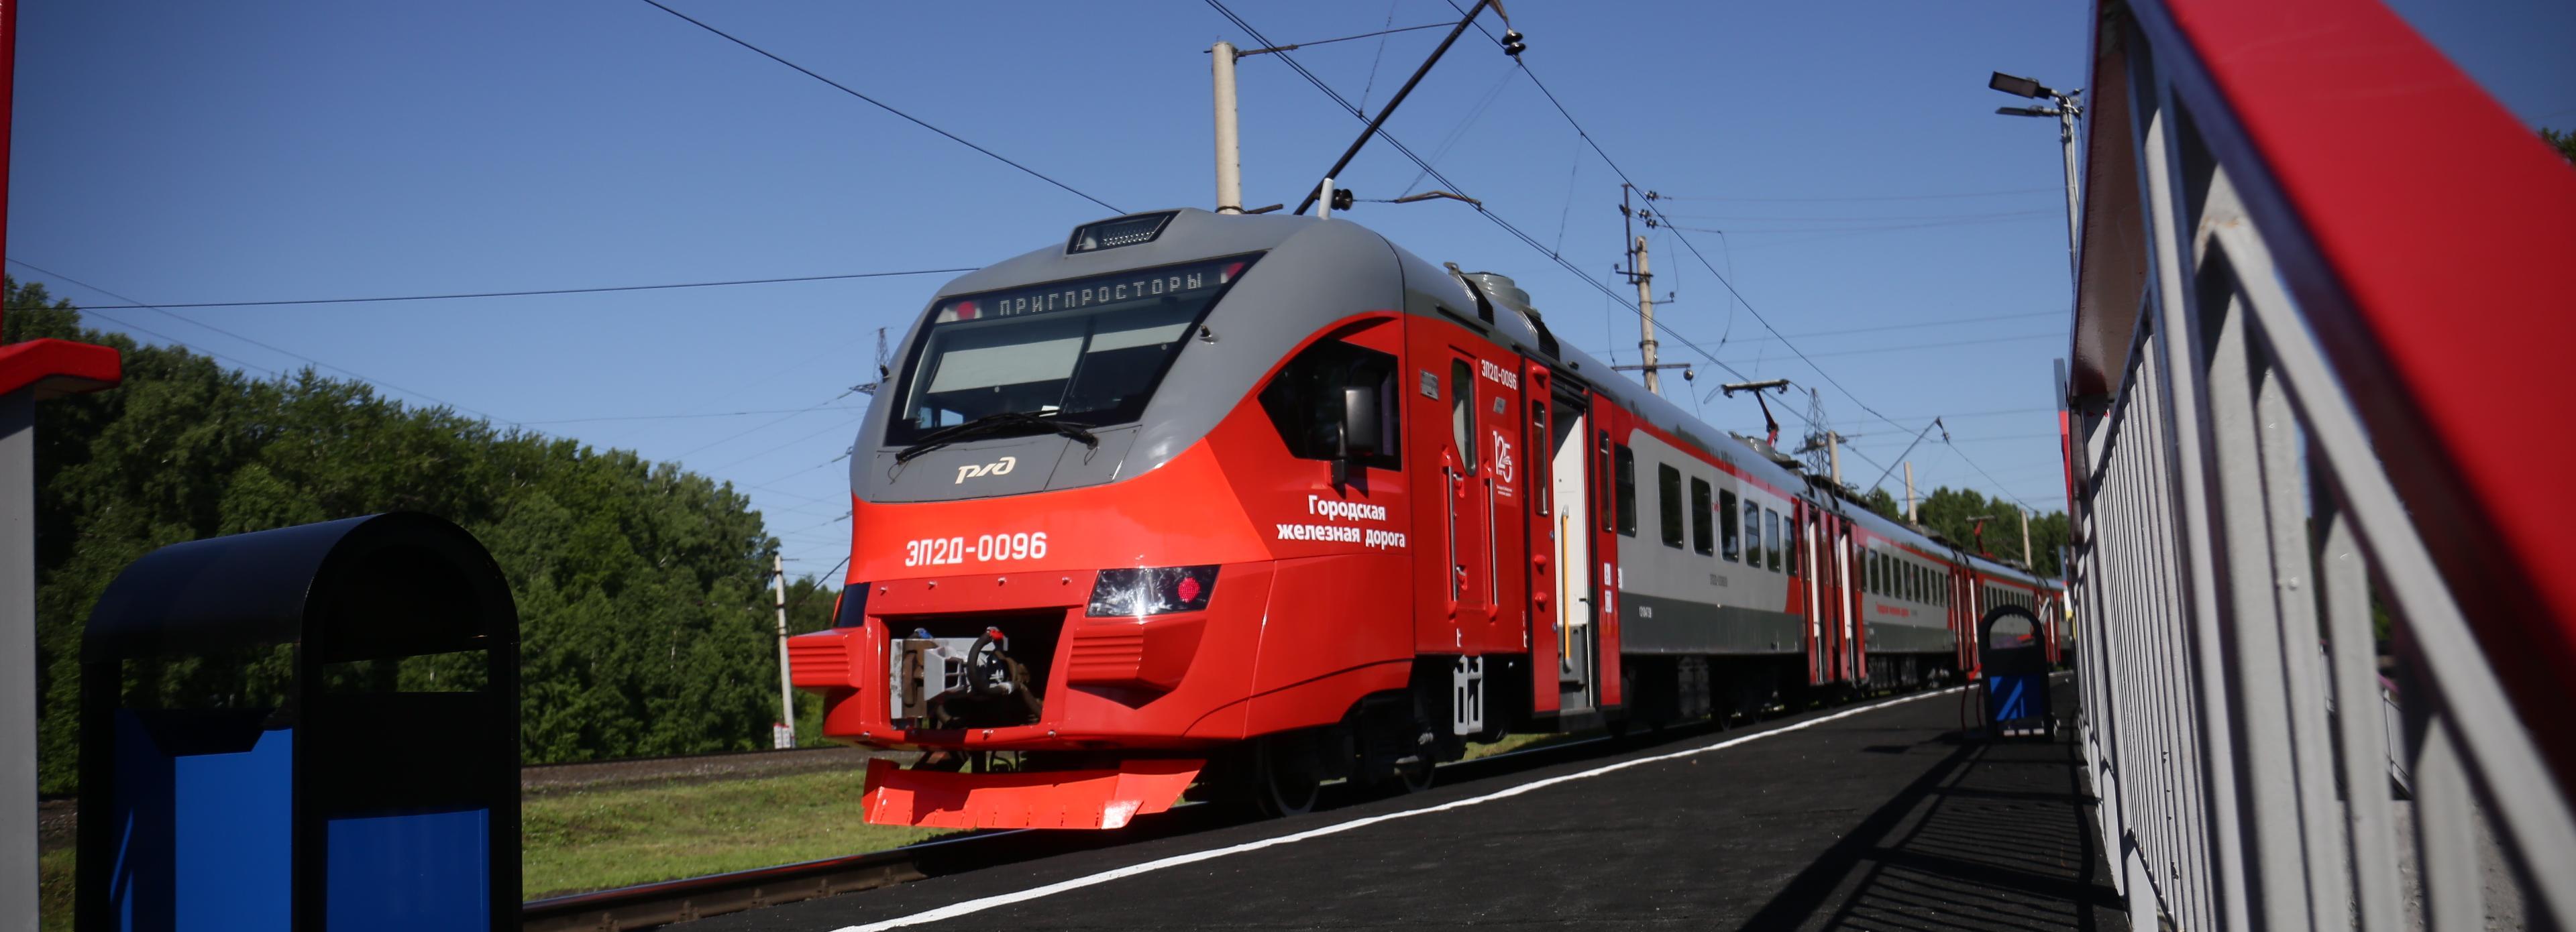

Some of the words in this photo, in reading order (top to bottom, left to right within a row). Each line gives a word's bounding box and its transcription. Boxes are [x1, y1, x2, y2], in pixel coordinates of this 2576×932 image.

[1000, 273, 1201, 316] ПРИГПРОСТОРЫ
[1481, 359, 1517, 390] ЭП2Д-0096
[1493, 430, 1512, 483] 125
[1308, 495, 1385, 521] Городская
[905, 532, 1047, 567] ЭП2Д-0096
[1276, 524, 1360, 542] железная
[1365, 528, 1405, 550] дорога
